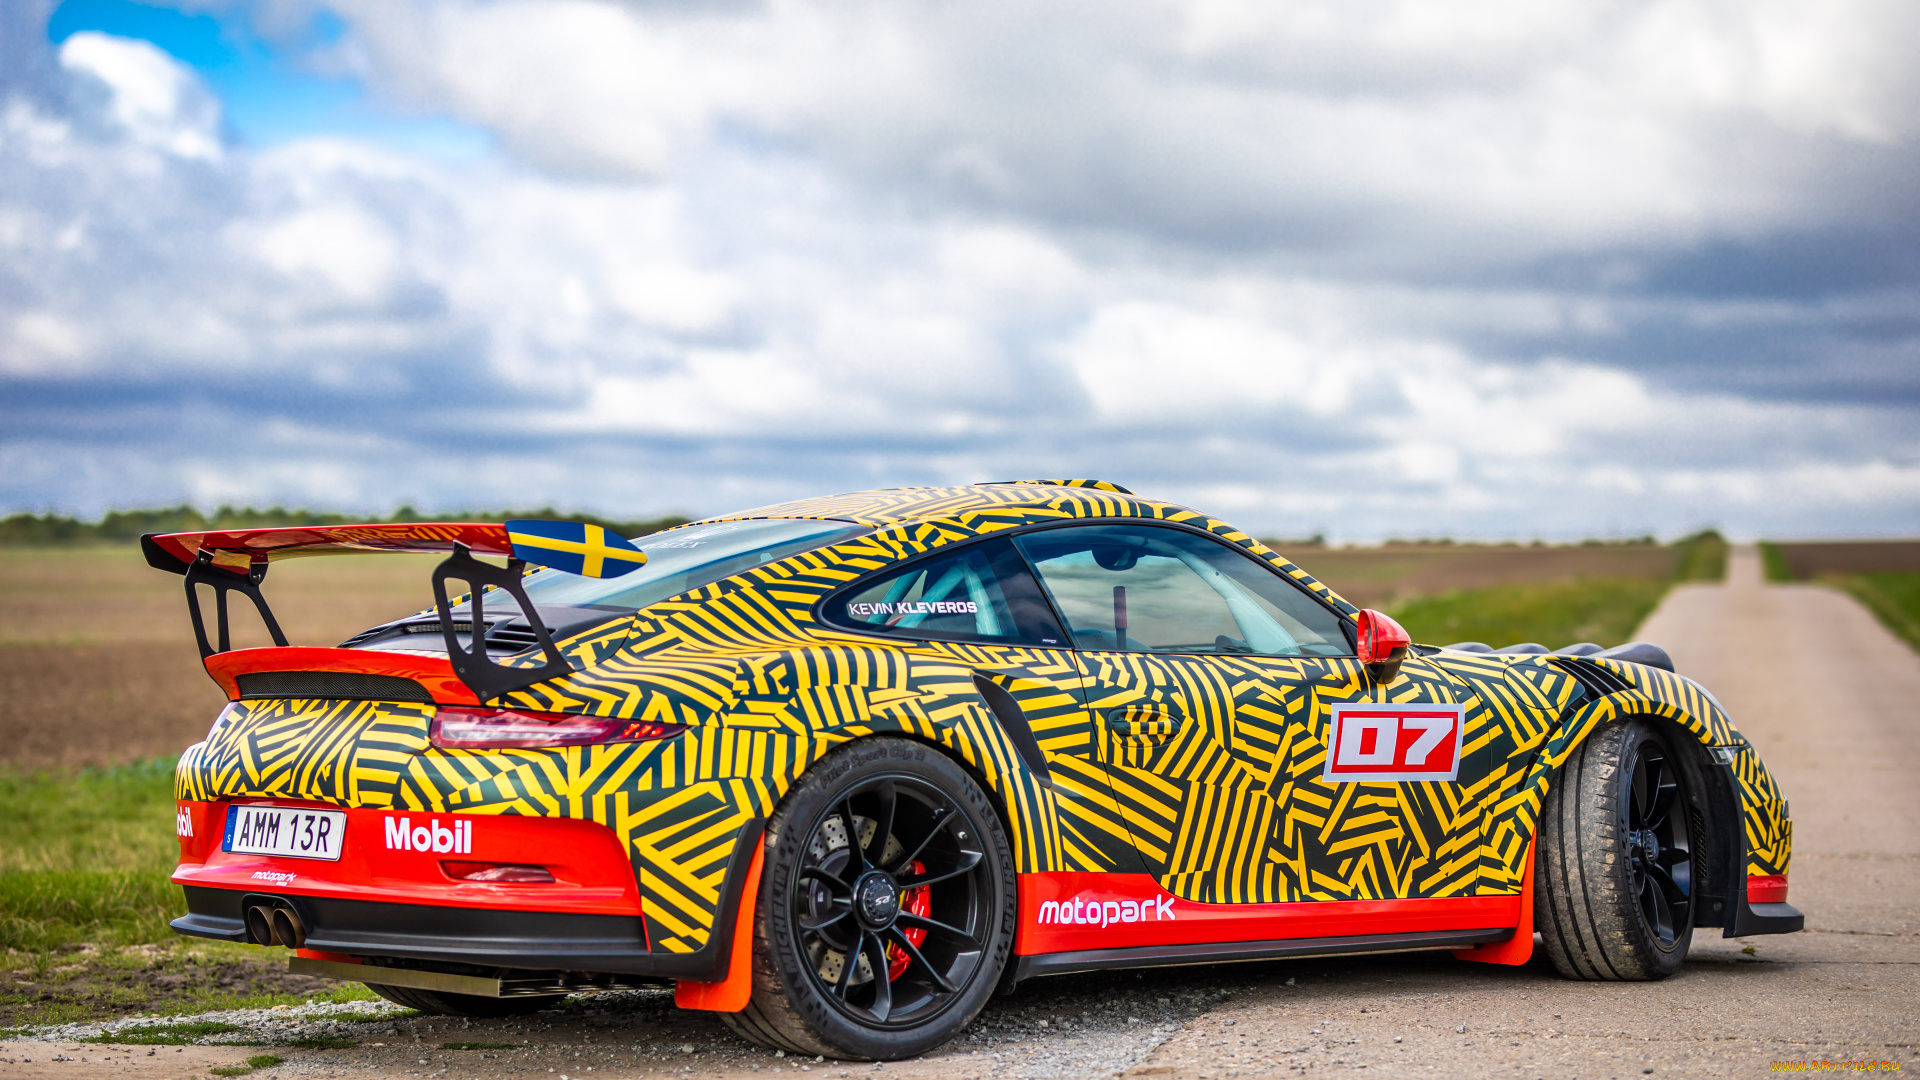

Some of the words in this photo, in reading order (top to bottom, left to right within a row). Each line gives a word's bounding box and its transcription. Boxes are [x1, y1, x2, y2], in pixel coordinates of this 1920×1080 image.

[849, 602, 894, 615] KEVIN
[897, 601, 978, 614] KLEVEROS
[1336, 717, 1454, 766] 07
[820, 761, 850, 789] Pilot
[850, 747, 888, 767] Sport
[889, 747, 913, 760] Cup
[177, 805, 193, 837] obil
[226, 834, 231, 843] S
[239, 811, 281, 848] AMM
[290, 814, 331, 852] 13R
[385, 816, 472, 854] Mobil
[251, 870, 297, 882] motopark
[994, 829, 1015, 933] MICHELIN
[773, 863, 798, 973] MICHELIN
[1038, 894, 1176, 929] motopark
